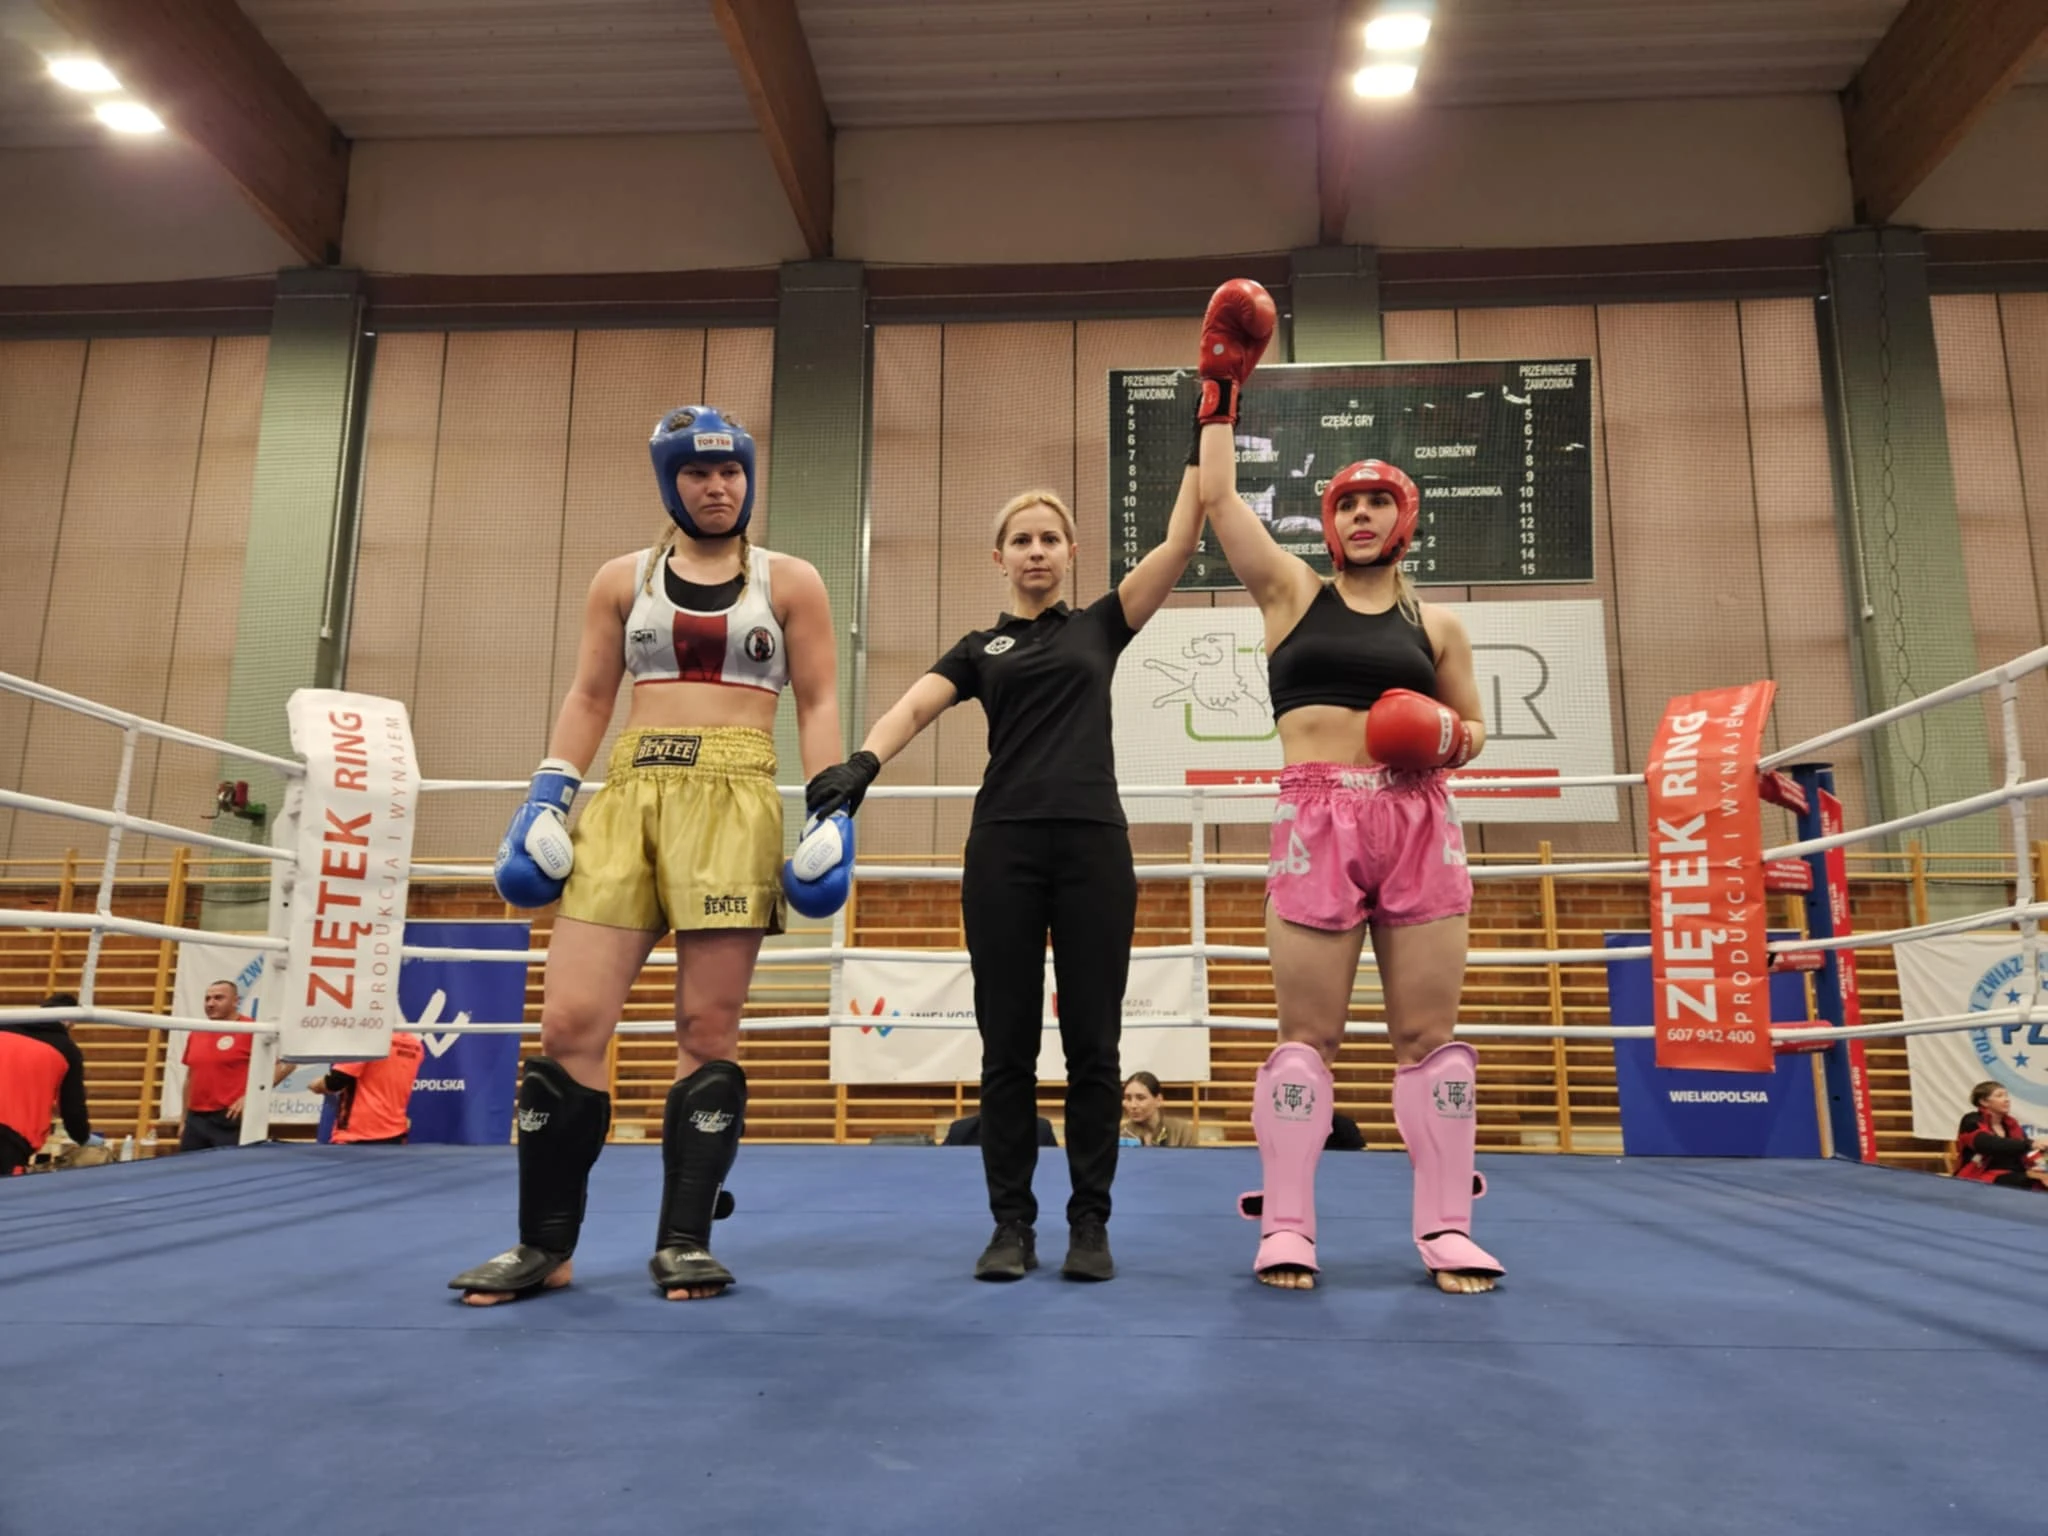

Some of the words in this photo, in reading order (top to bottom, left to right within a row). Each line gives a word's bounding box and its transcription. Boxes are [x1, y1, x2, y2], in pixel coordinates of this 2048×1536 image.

[1126, 404, 1135, 415] 4
[1524, 409, 1533, 420] 5
[1127, 419, 1136, 431] 5
[1321, 412, 1352, 429] CZĘŚĆ
[1354, 414, 1374, 427] GRY
[1524, 424, 1533, 435] 6
[1127, 434, 1136, 446] 6
[1525, 439, 1534, 451] 7
[1128, 449, 1136, 461] 7
[1414, 447, 1437, 459] CZAS
[1525, 454, 1534, 466] 8
[1128, 464, 1136, 476] 8
[1526, 470, 1535, 482] 9
[1129, 480, 1137, 492] 9
[1519, 486, 1534, 498] 10
[1424, 487, 1449, 498] KARA
[1122, 495, 1137, 507] 10
[1520, 502, 1532, 514] 11
[1123, 512, 1135, 523] 11
[1427, 511, 1435, 524] 1
[1520, 516, 1535, 529] 12
[1123, 526, 1137, 538] 12
[1520, 532, 1535, 544] 13
[1123, 541, 1137, 552] 13
[1198, 540, 1206, 552] 2
[1427, 535, 1436, 548] 2
[1520, 548, 1535, 560] 14
[1197, 564, 1206, 576] 3
[1427, 559, 1436, 571] 3
[1520, 563, 1536, 575] 15
[328, 710, 368, 792] RING
[637, 743, 695, 759] BENLEE
[1662, 709, 1708, 798] RING
[1720, 703, 1748, 817] WYNAJEM
[370, 856, 400, 1010] PRODUKCJA
[385, 717, 406, 819] WYNAJEM
[306, 807, 373, 1009] ZIĘTEK
[704, 900, 748, 915] BENLEE
[1657, 813, 1728, 1022] ZIĘTEK
[1725, 856, 1753, 1023] PRODUKCJA
[301, 1016, 327, 1029] 607
[330, 1016, 356, 1029] 942
[359, 1016, 384, 1029] 400
[1667, 1028, 1693, 1042] 607
[1696, 1029, 1724, 1043] 942
[1727, 1030, 1756, 1044] 400
[412, 1079, 466, 1092] OPOLSKA
[1669, 1090, 1769, 1104] WIELKOPOLSKA
